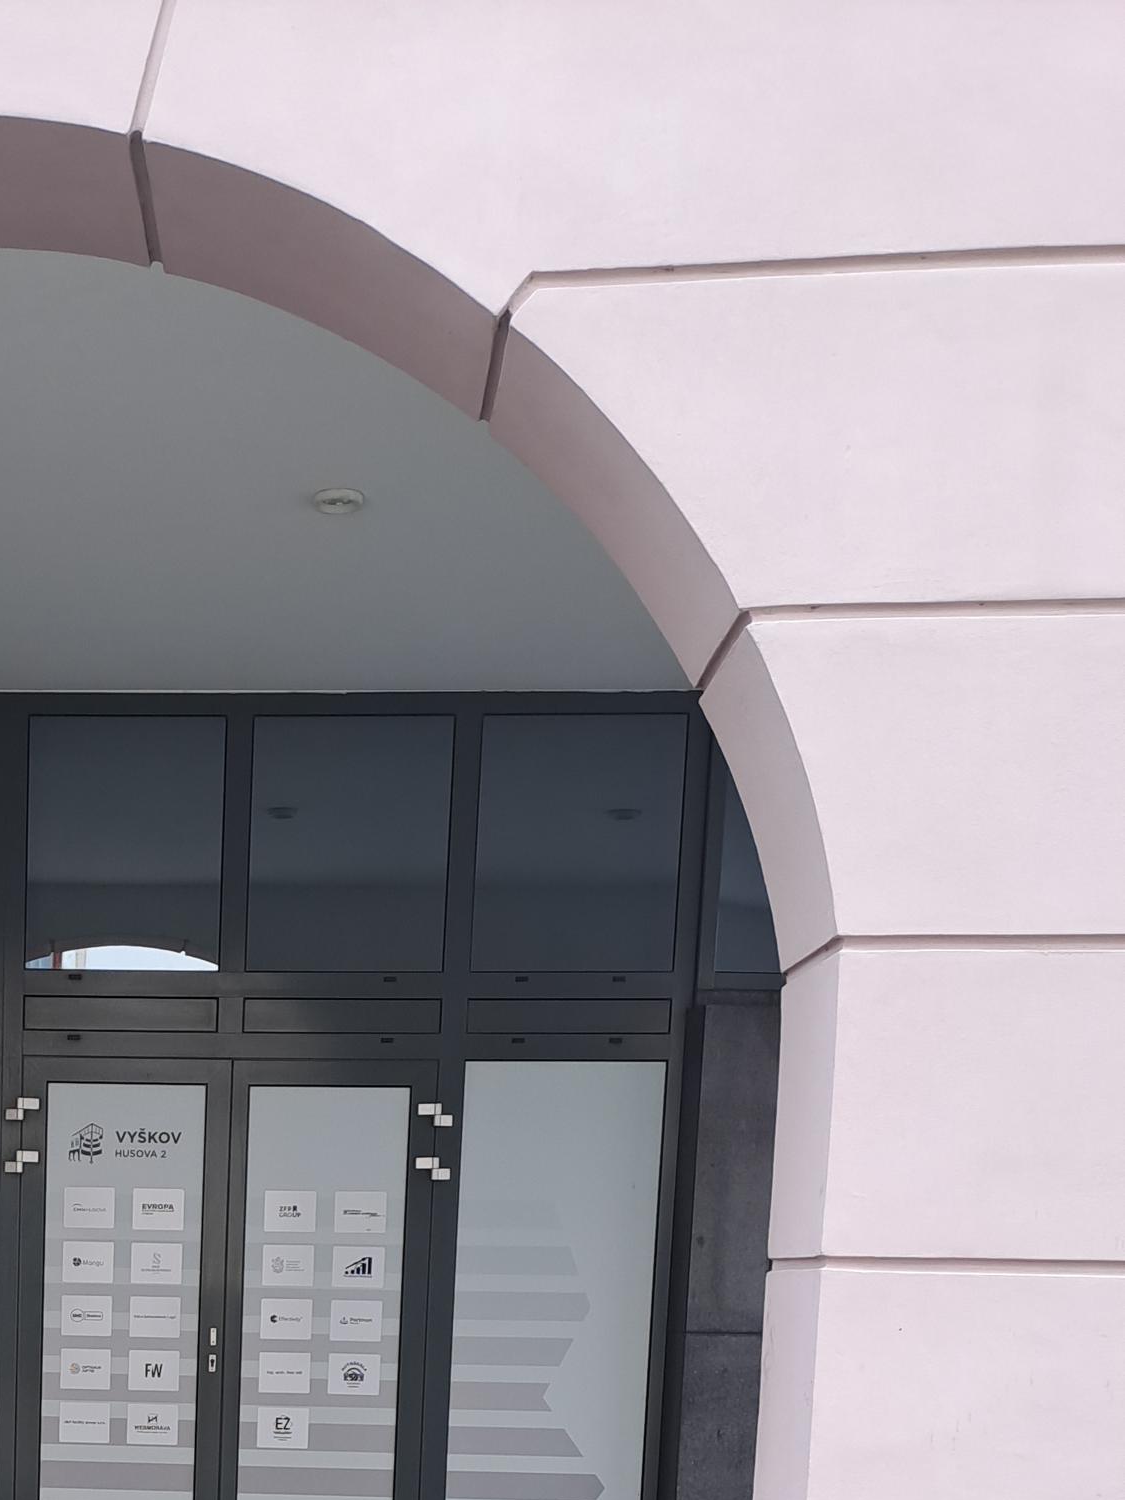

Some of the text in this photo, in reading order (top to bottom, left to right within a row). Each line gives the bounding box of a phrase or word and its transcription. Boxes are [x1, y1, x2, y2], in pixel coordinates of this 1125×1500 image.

[115, 1128, 182, 1145] VYŠKOV
[114, 1149, 167, 1159] HUSOVA 2
[144, 1363, 164, 1378] FW
[275, 1416, 291, 1430] EZ
